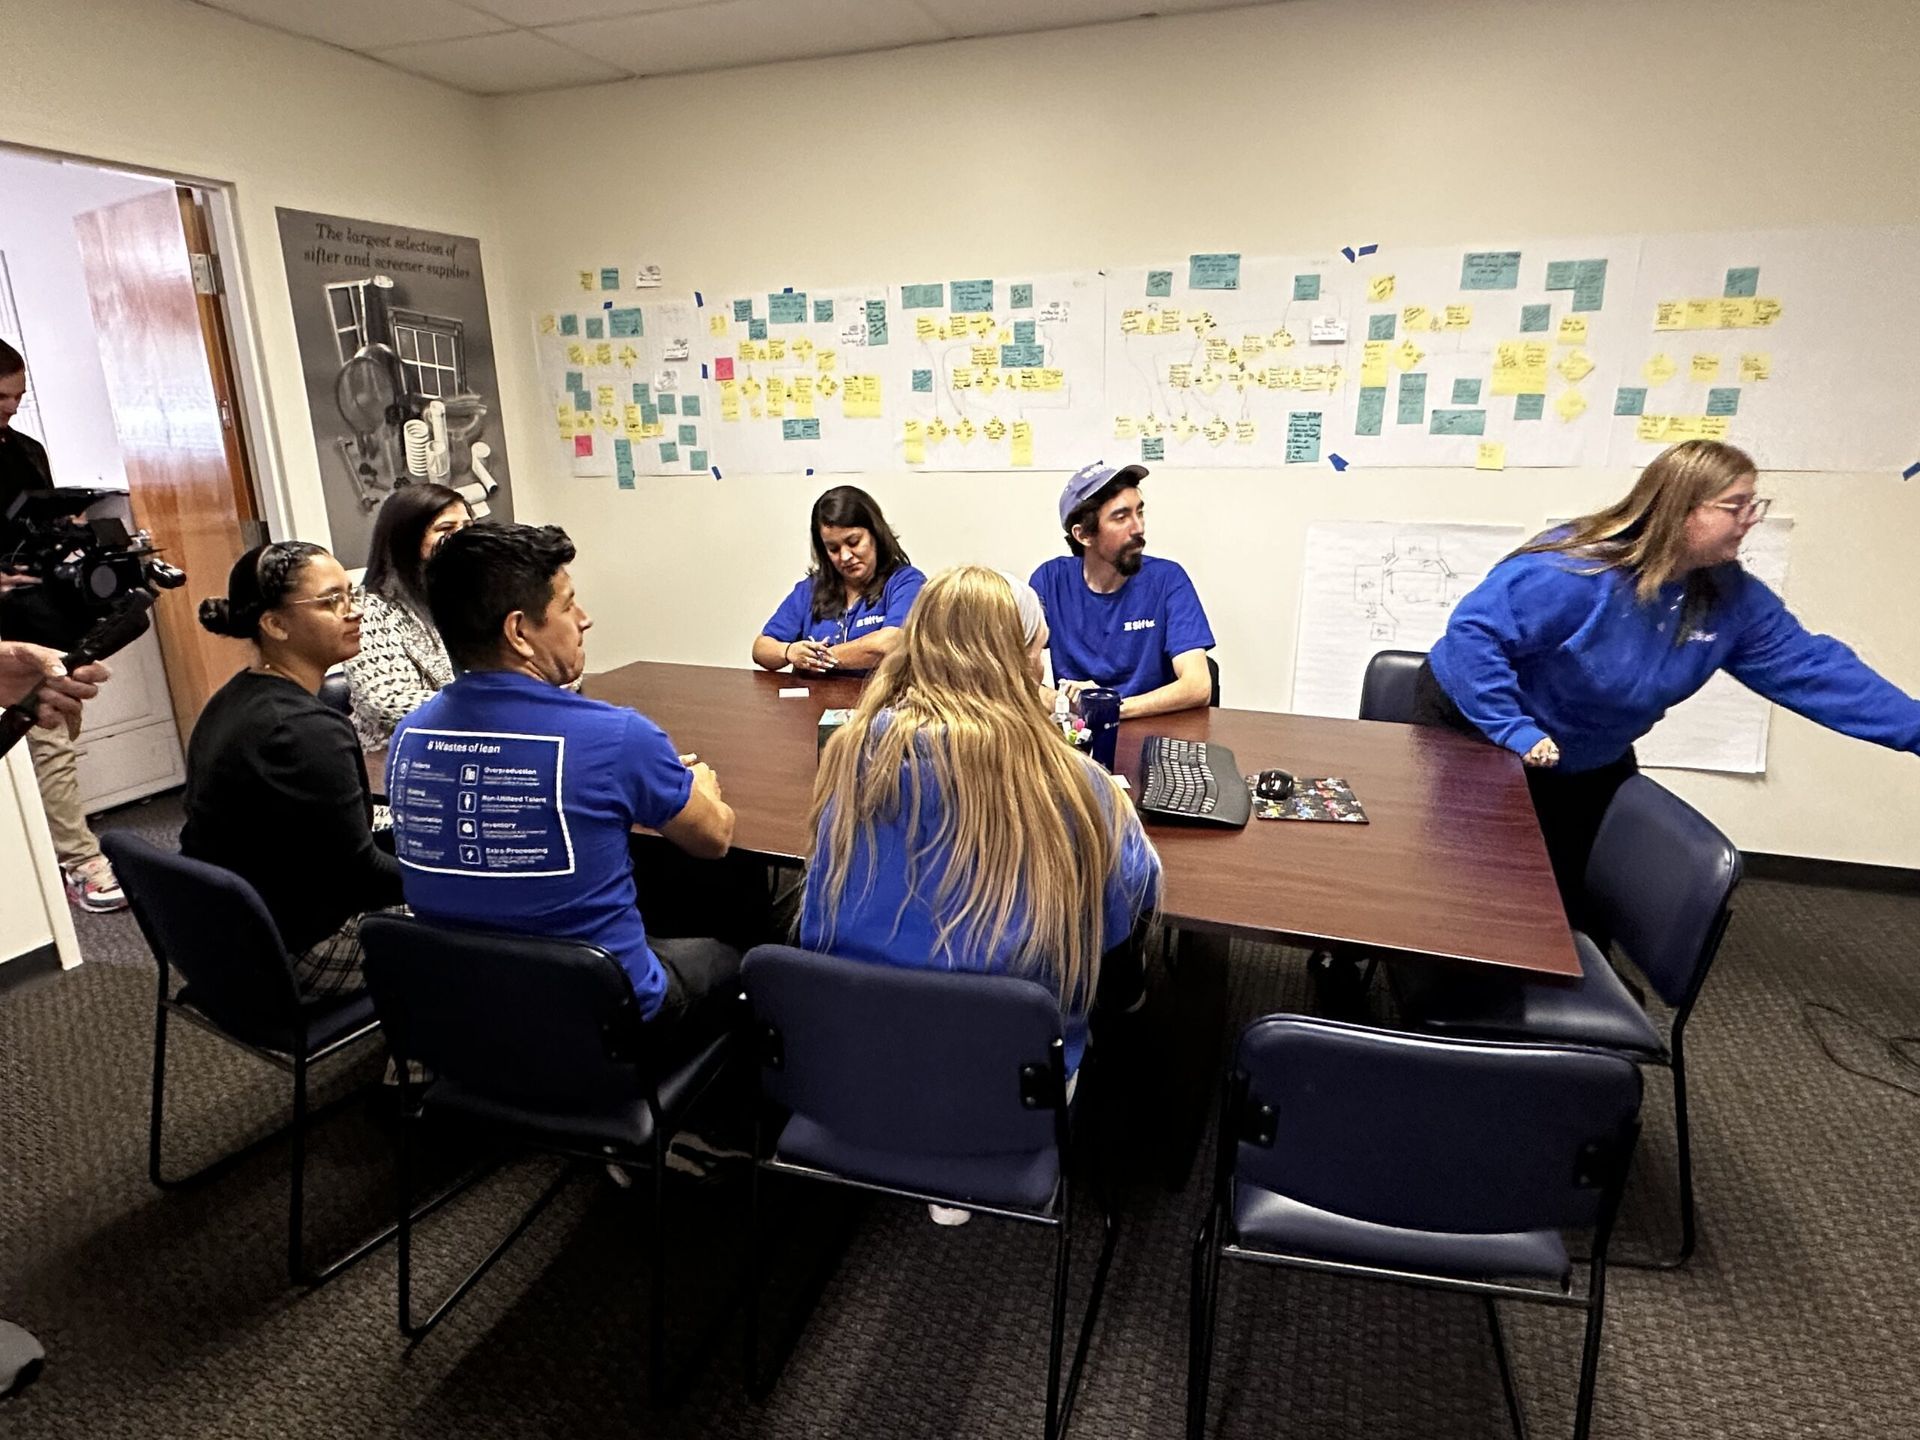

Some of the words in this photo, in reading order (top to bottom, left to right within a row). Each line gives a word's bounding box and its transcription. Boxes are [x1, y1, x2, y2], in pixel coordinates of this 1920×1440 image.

[316, 223, 342, 241] The
[346, 227, 391, 249] largest
[394, 236, 443, 257] selection
[446, 243, 457, 262] of
[303, 246, 341, 266] sifter
[344, 252, 371, 267] and
[374, 257, 424, 273] screener
[426, 263, 471, 280] supplies
[435, 740, 467, 752] Wastes
[468, 743, 479, 752] of
[479, 744, 500, 753] lean
[484, 766, 537, 775] Overproduction
